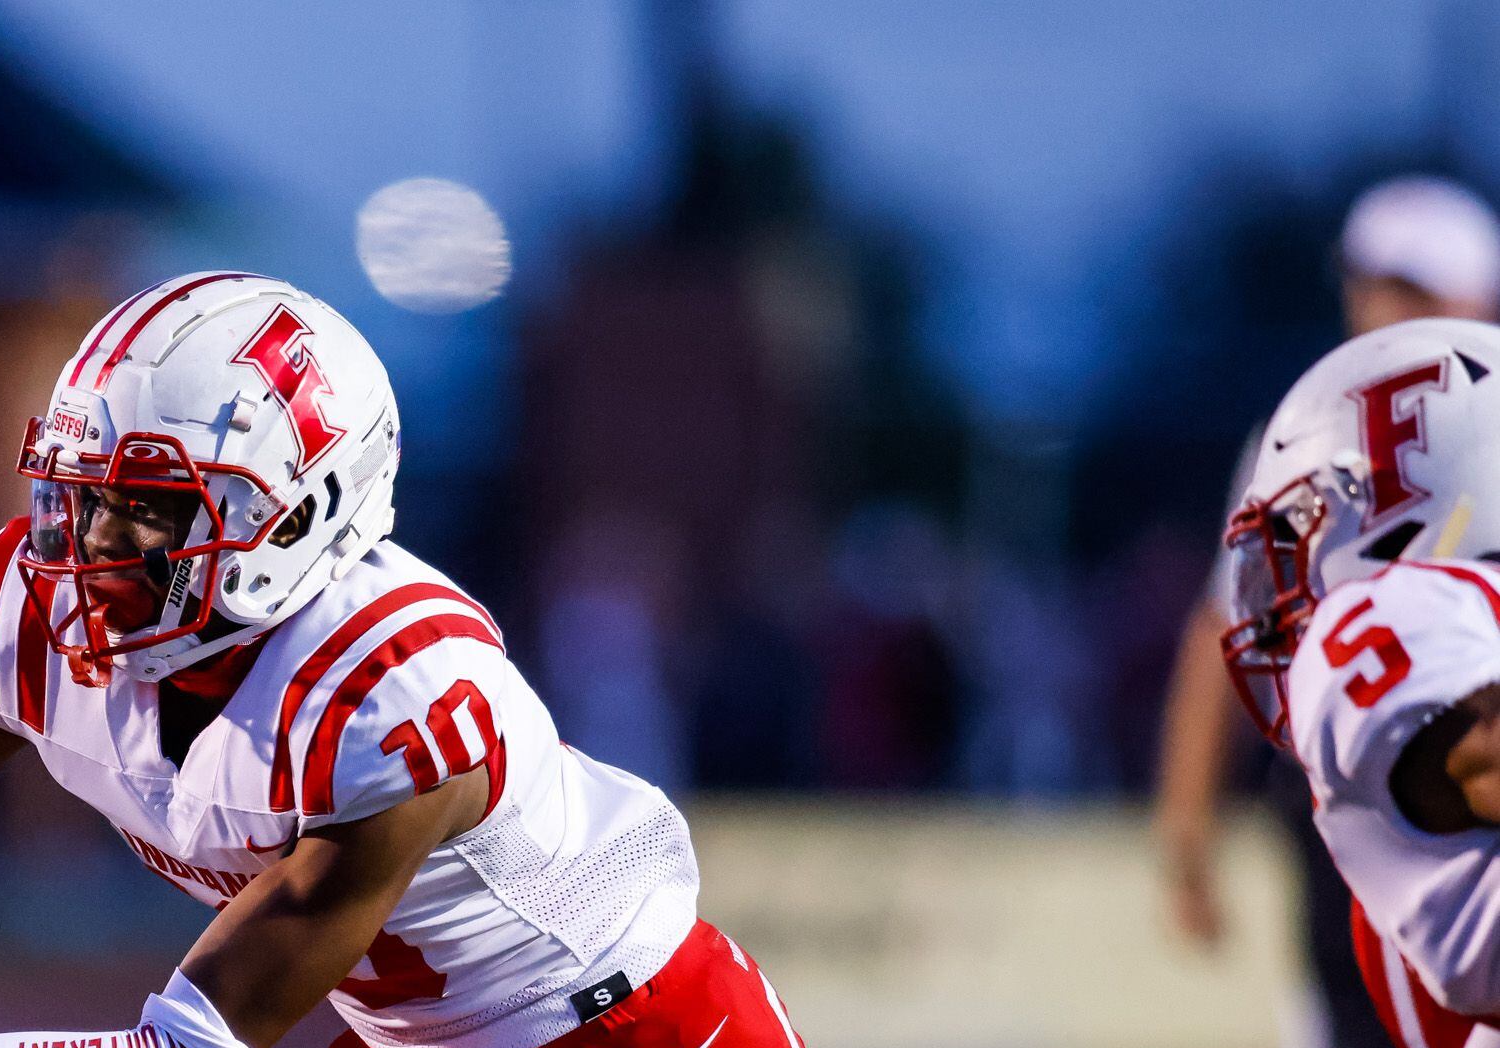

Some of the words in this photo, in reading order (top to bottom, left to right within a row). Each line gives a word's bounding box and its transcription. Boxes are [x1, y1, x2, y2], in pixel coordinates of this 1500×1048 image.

[53, 412, 84, 440] SFFS
[227, 302, 349, 482] F
[1345, 355, 1453, 534] F
[1322, 598, 1412, 709] 5
[379, 679, 500, 796] 10
[119, 826, 260, 899] INDIAN
[593, 988, 613, 1006] S
